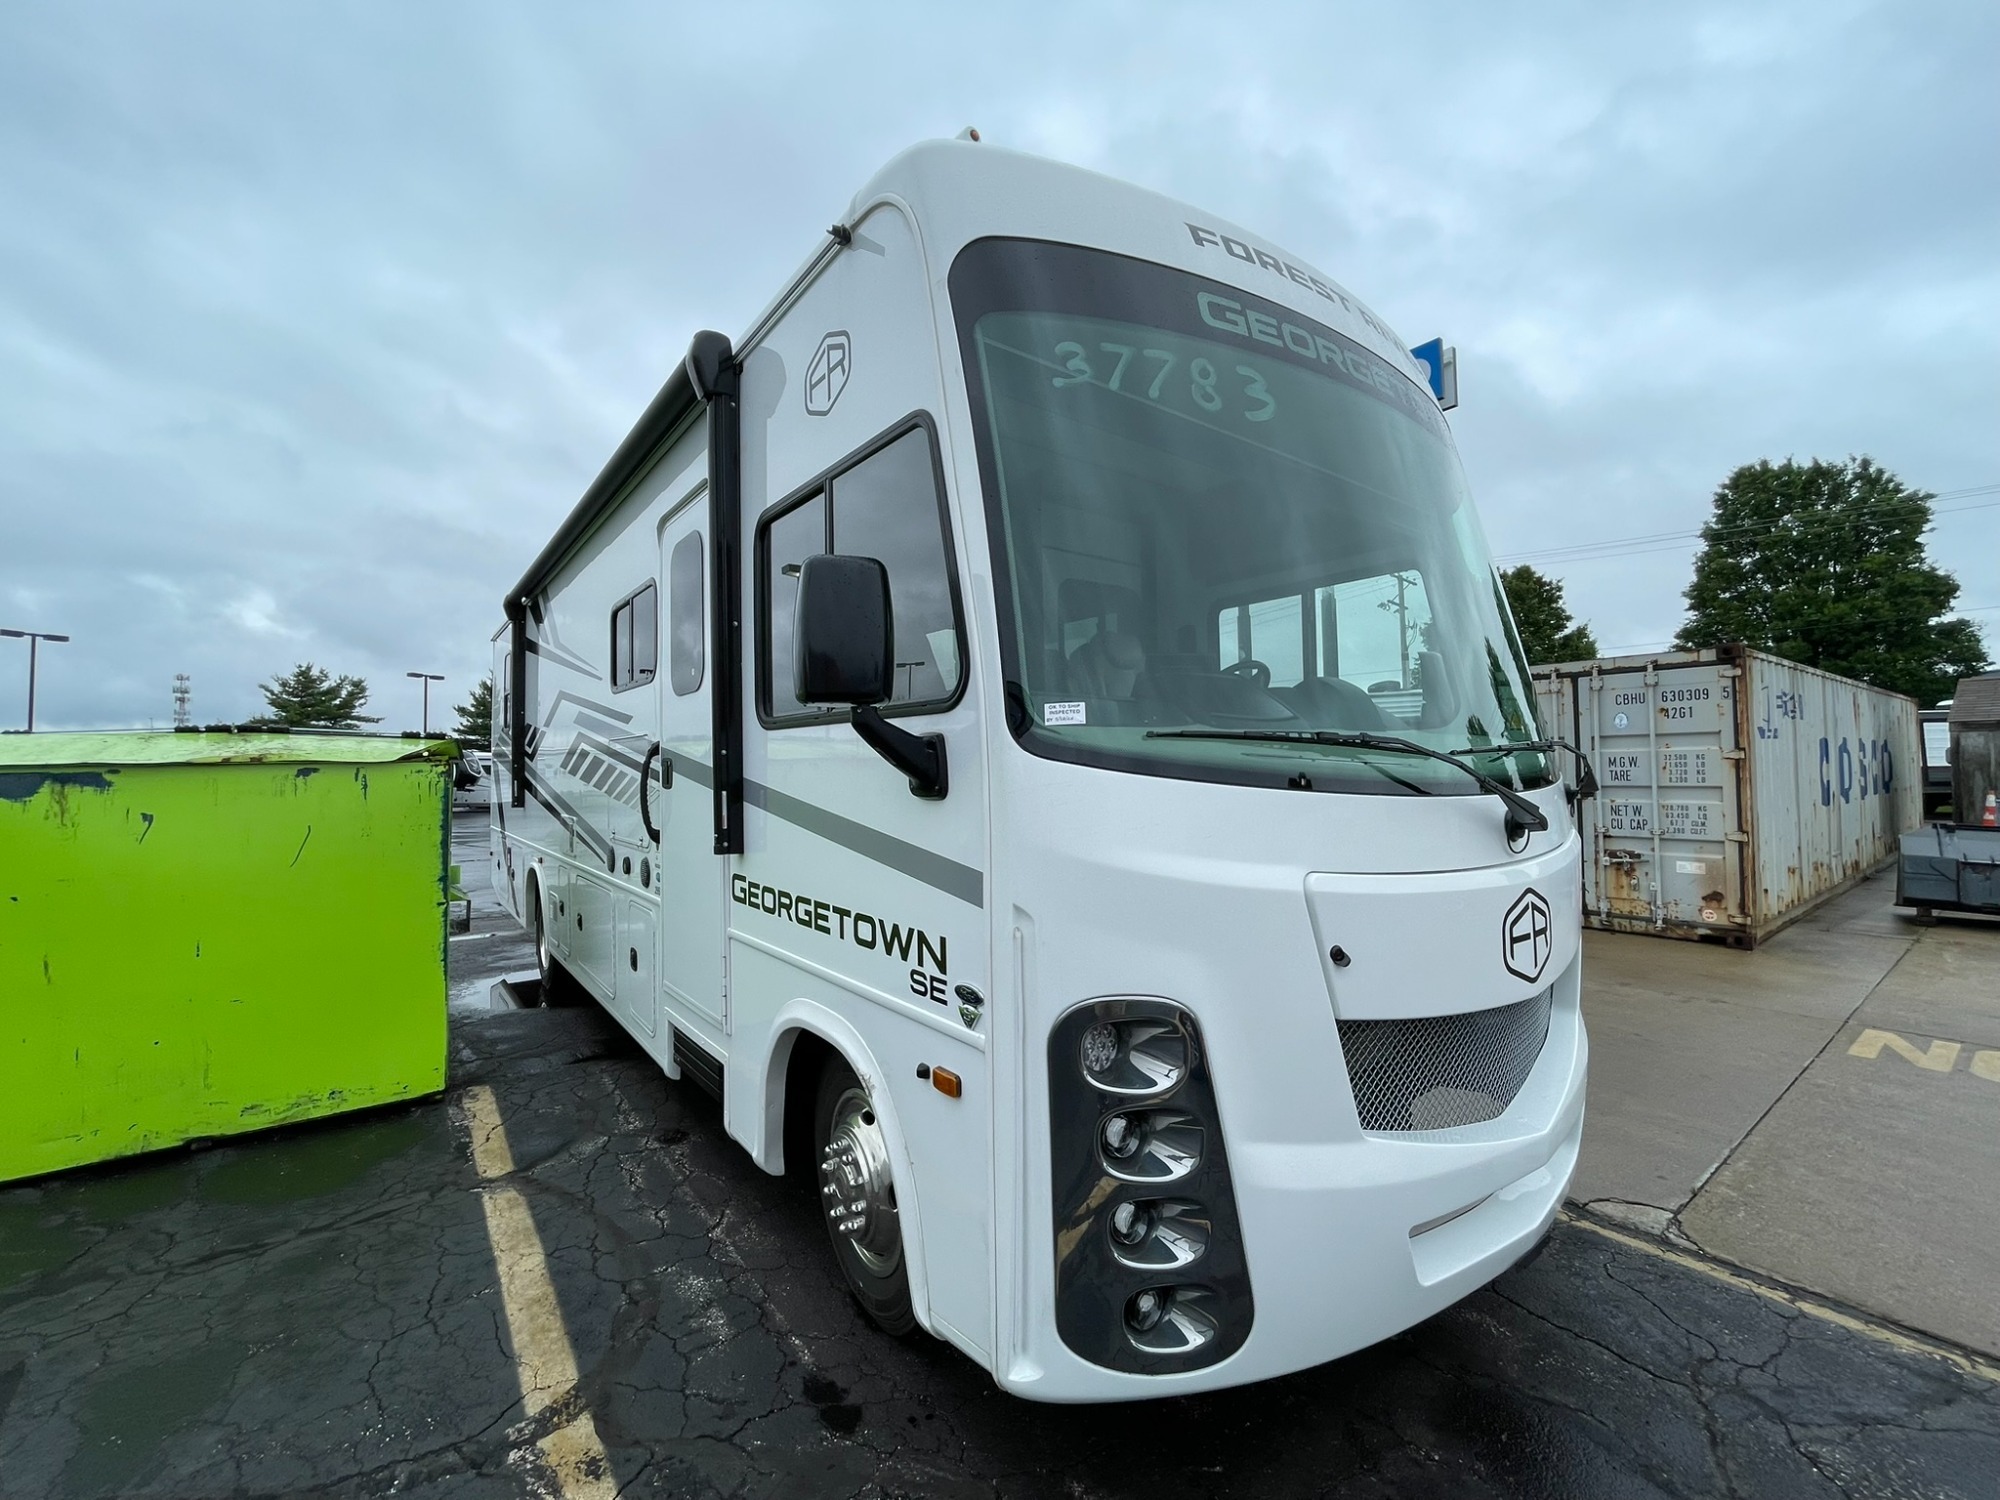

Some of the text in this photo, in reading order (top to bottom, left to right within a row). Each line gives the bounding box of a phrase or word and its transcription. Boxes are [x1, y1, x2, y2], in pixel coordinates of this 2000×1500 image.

[1184, 222, 1351, 313] FOREST
[1052, 341, 1277, 422] 37783
[1615, 686, 1730, 706] CBHU 630309 5
[1663, 706, 1693, 719] 42G1
[1608, 756, 1640, 768] M.G.W.
[1609, 769, 1631, 782] TARE
[1610, 804, 1629, 817] NET
[1632, 805, 1644, 817] W.
[1610, 818, 1626, 830] CU.
[732, 873, 947, 976] GEORGETOWN
[910, 968, 948, 1006] SE
